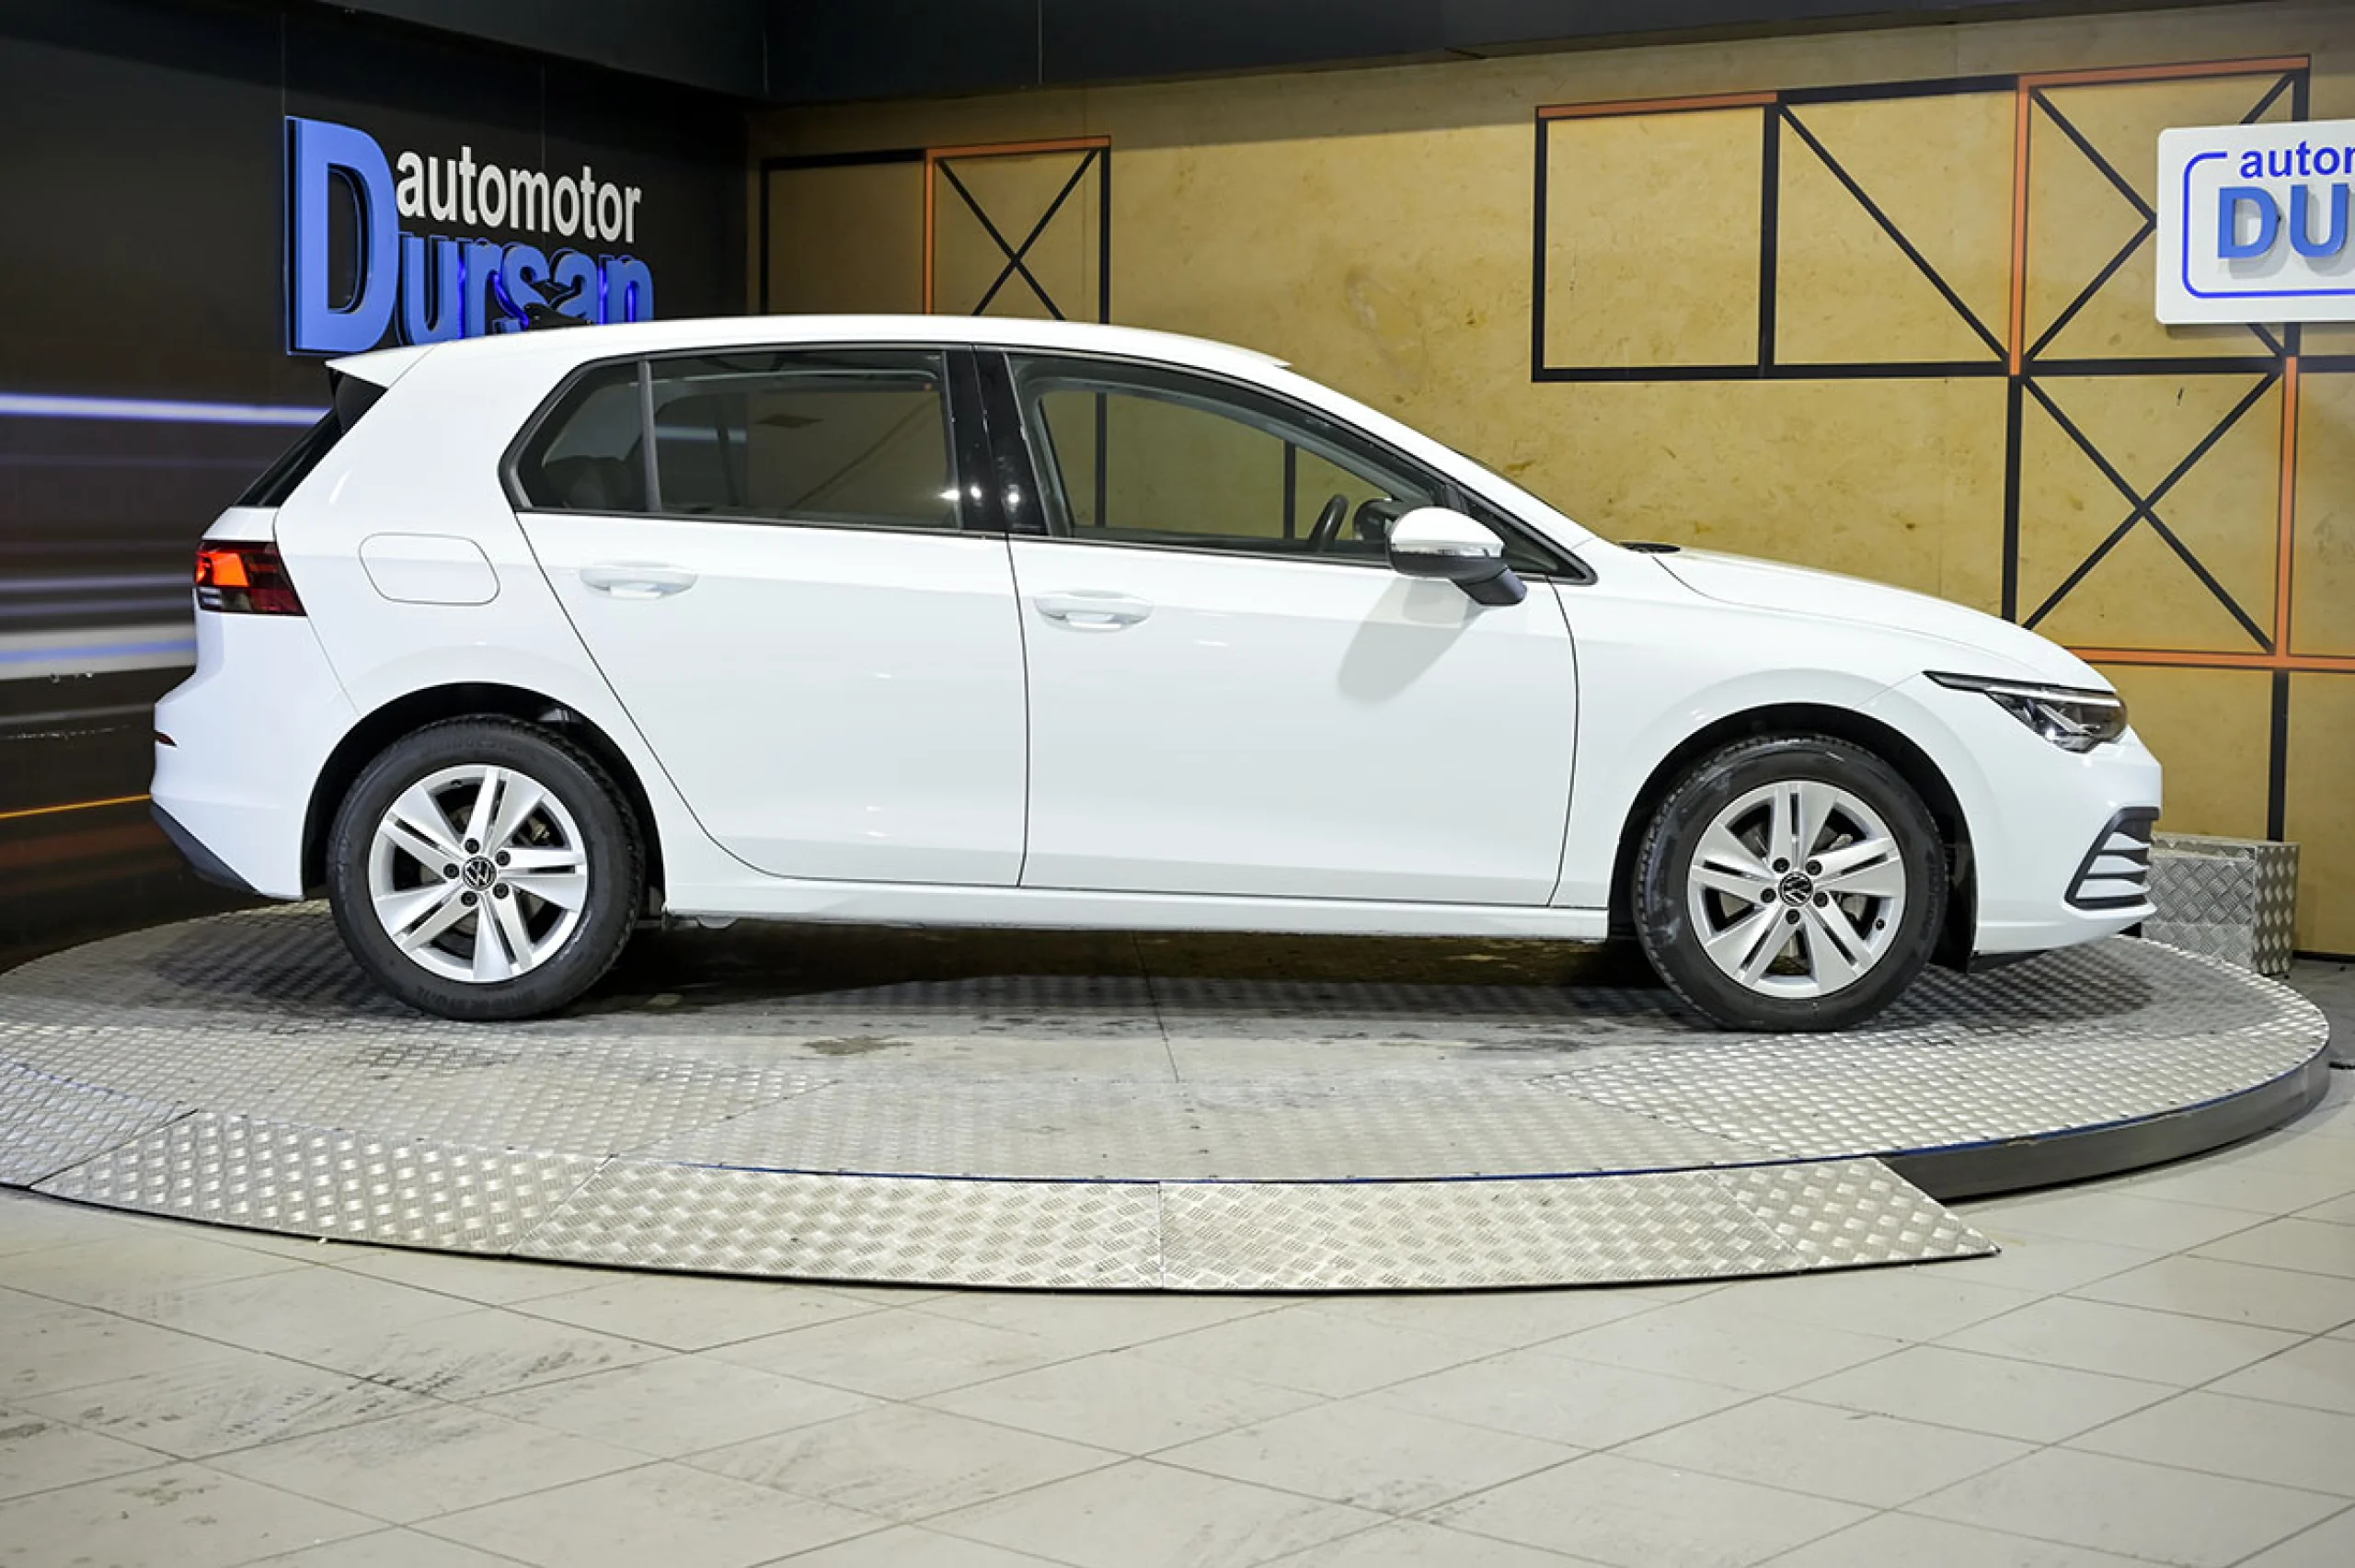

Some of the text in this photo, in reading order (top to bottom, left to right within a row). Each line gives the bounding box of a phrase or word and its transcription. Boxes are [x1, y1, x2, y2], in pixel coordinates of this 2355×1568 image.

[396, 145, 641, 244] automotor
[2239, 141, 2355, 178] auto
[284, 116, 655, 355] Dursan
